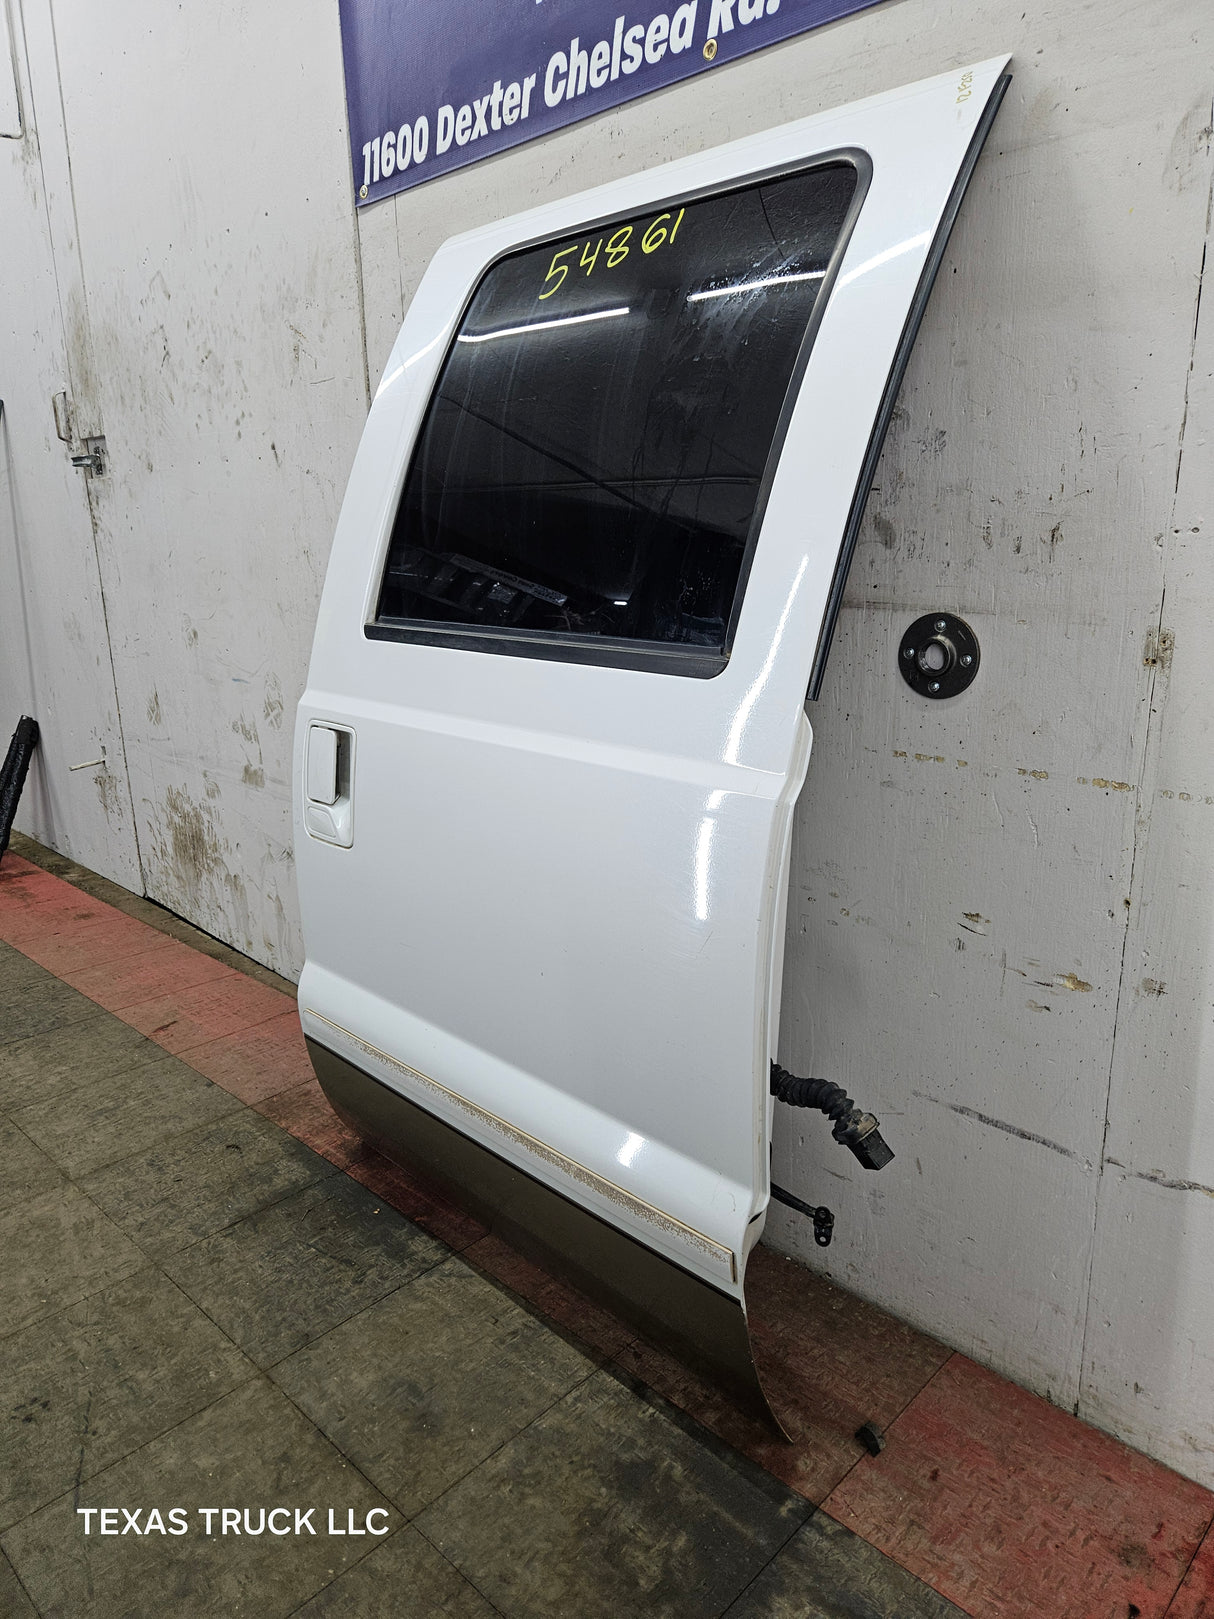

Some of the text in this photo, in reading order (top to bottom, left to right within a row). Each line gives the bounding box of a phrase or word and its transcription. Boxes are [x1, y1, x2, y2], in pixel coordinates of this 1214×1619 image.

[362, 115, 429, 185] 11600
[436, 72, 537, 156] Dexter
[544, 0, 698, 108] Chelsea
[538, 207, 686, 300] 54861
